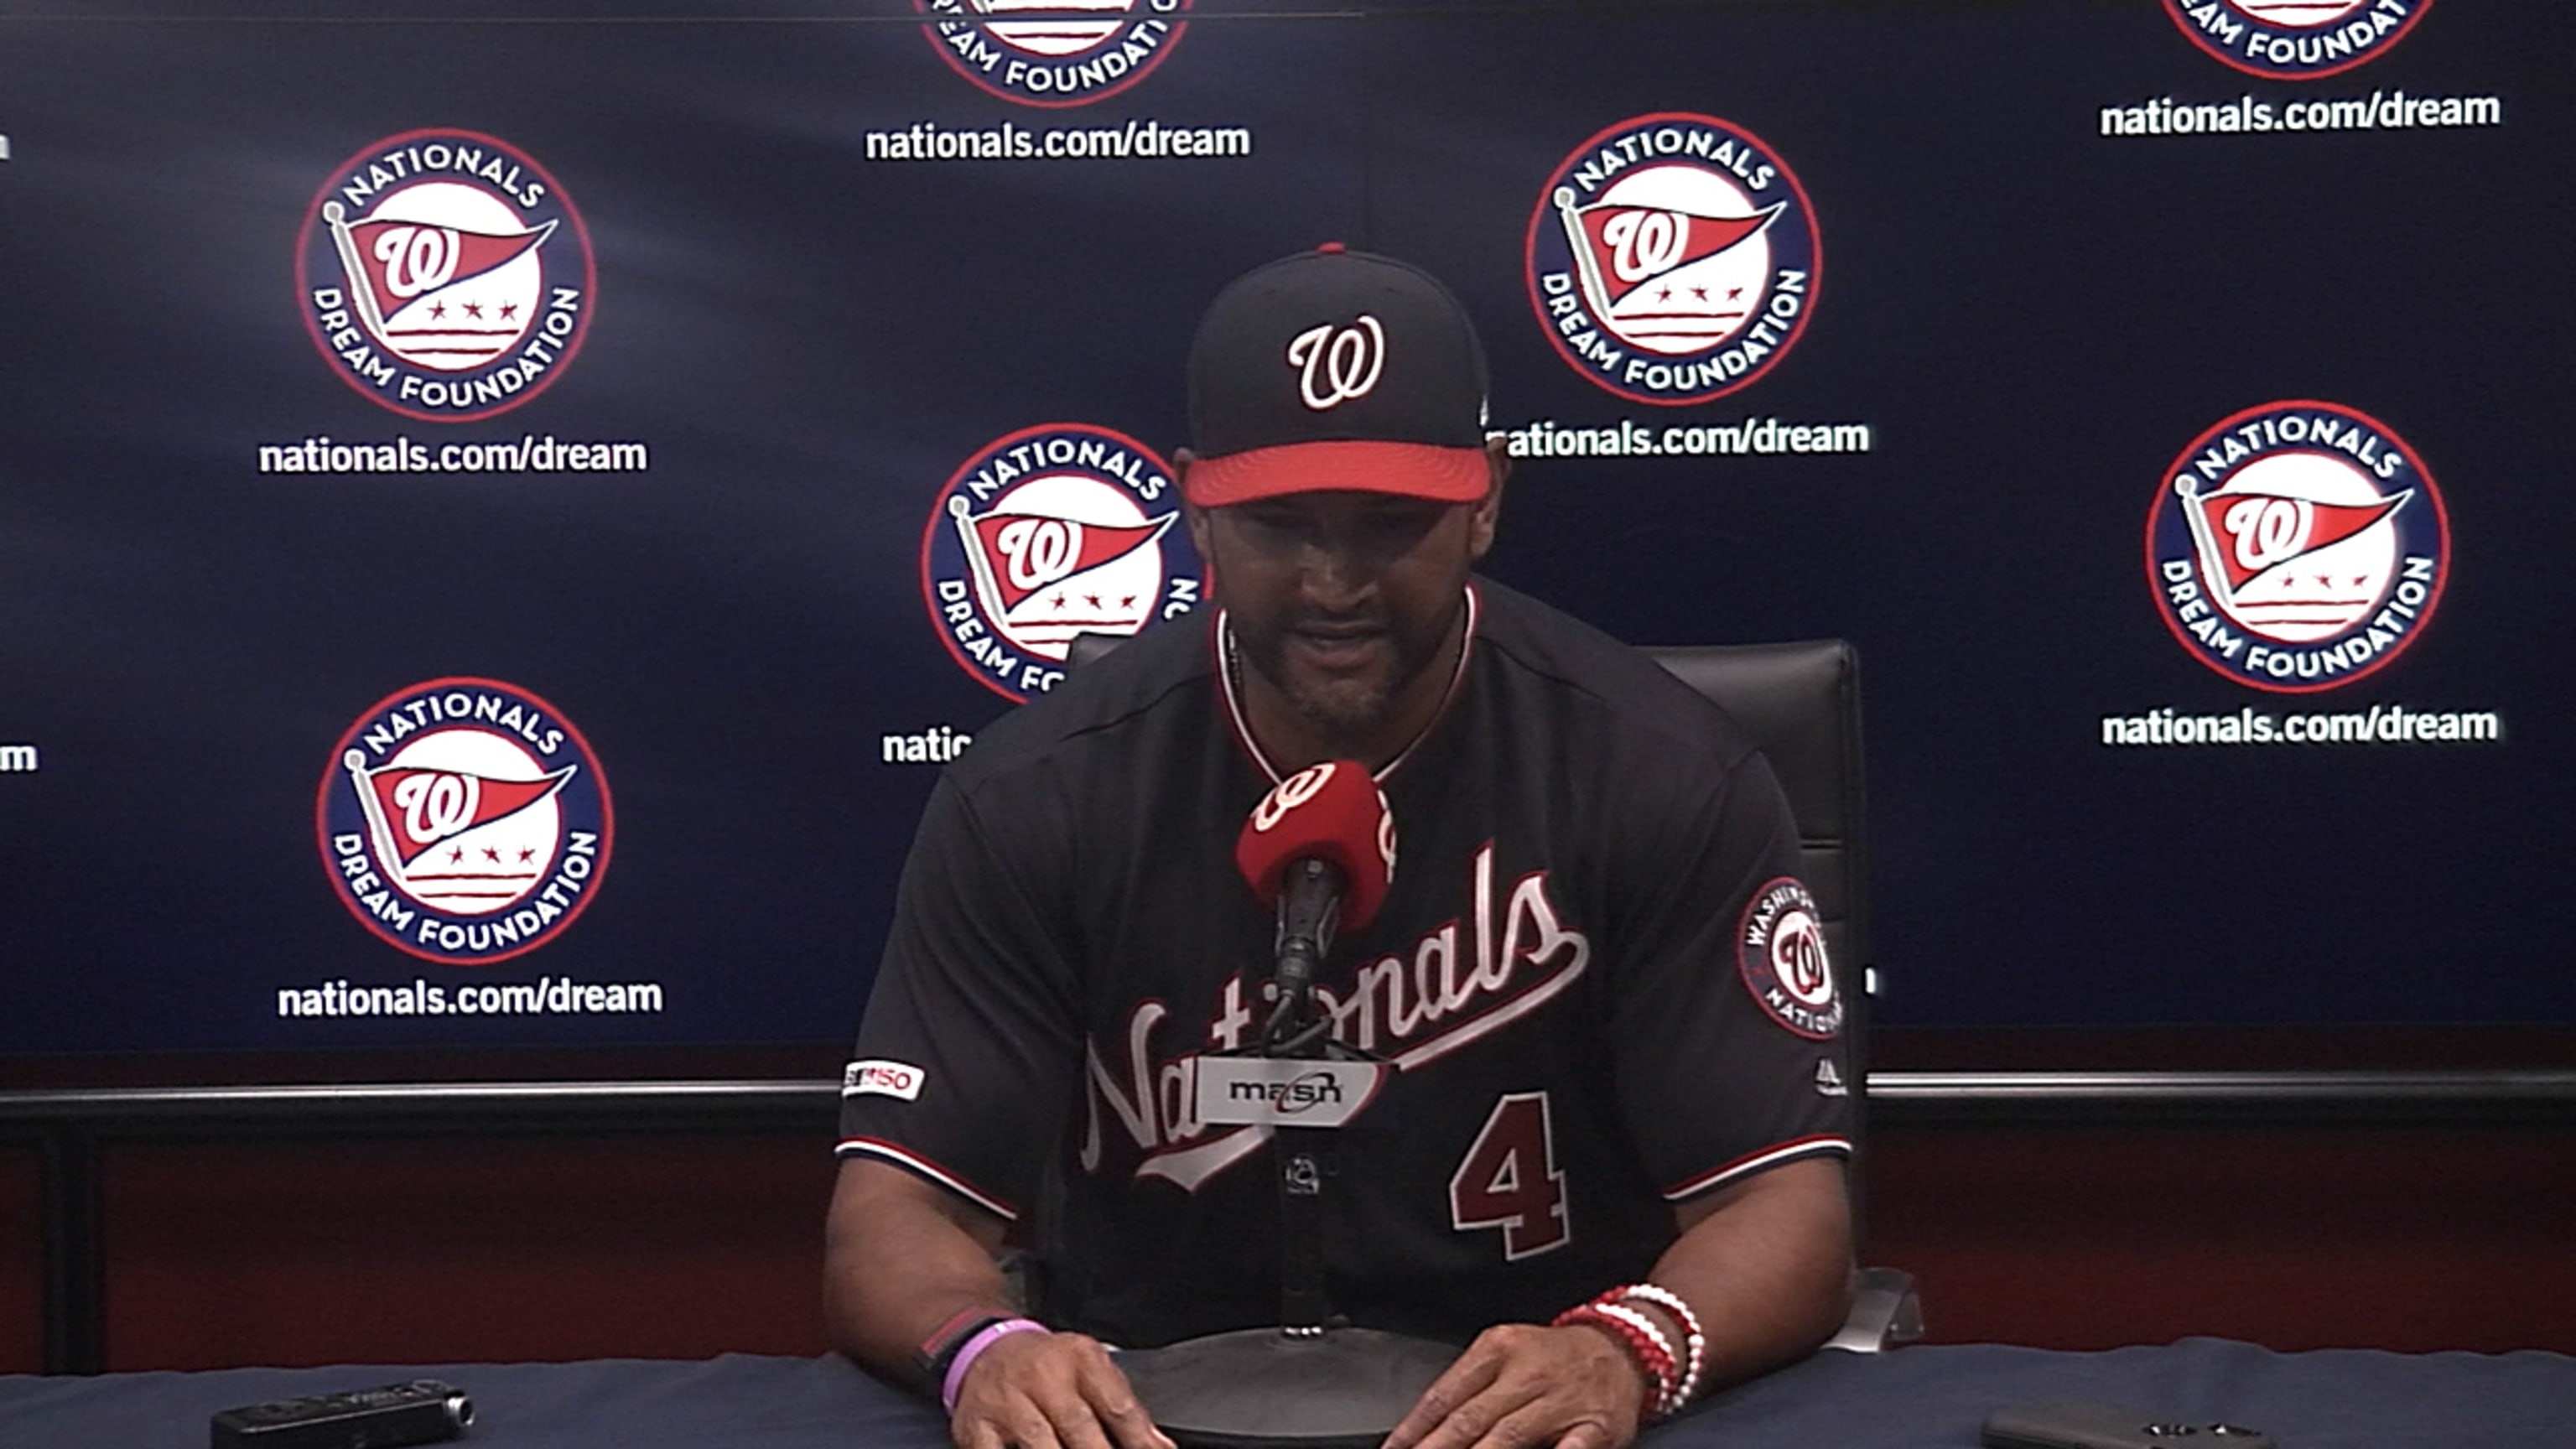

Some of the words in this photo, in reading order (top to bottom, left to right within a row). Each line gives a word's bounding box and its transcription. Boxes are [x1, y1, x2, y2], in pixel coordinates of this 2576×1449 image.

[2246, 0, 2408, 64] FOUNDAT
[866, 121, 1250, 158] nationals.com/dream
[2100, 91, 2501, 135] nationals.com/dream
[343, 144, 545, 207] NATIONALS
[1574, 128, 1775, 192] NATIONALS
[374, 226, 460, 297] W
[1603, 210, 1689, 282] W
[314, 287, 396, 387] DREAM
[401, 287, 580, 407] FOUNDATION
[1288, 315, 1384, 409] W
[1543, 273, 1622, 371] DREAM
[1624, 269, 1806, 390] FOUNDATION
[259, 437, 647, 472] nationals.com/dream
[968, 439, 1166, 501] NATIONALS
[2195, 415, 2402, 479] NATIONALS
[997, 518, 1083, 590] W
[2225, 499, 2313, 570] W
[938, 580, 1018, 678] DREAM
[2162, 560, 2243, 659] DREAM
[2245, 556, 2433, 678] FOUNDATION
[363, 693, 564, 756] NATIONALS
[2102, 706, 2498, 744] nationals.com/dream
[394, 773, 480, 841] W
[335, 834, 414, 932] DREAM
[418, 832, 597, 951] FOUNDATION
[278, 979, 662, 1015] nationals.com/dream
[1080, 839, 1590, 1194] Natnals
[1229, 1073, 1342, 1104] masn
[1448, 1091, 1571, 1261] 4
